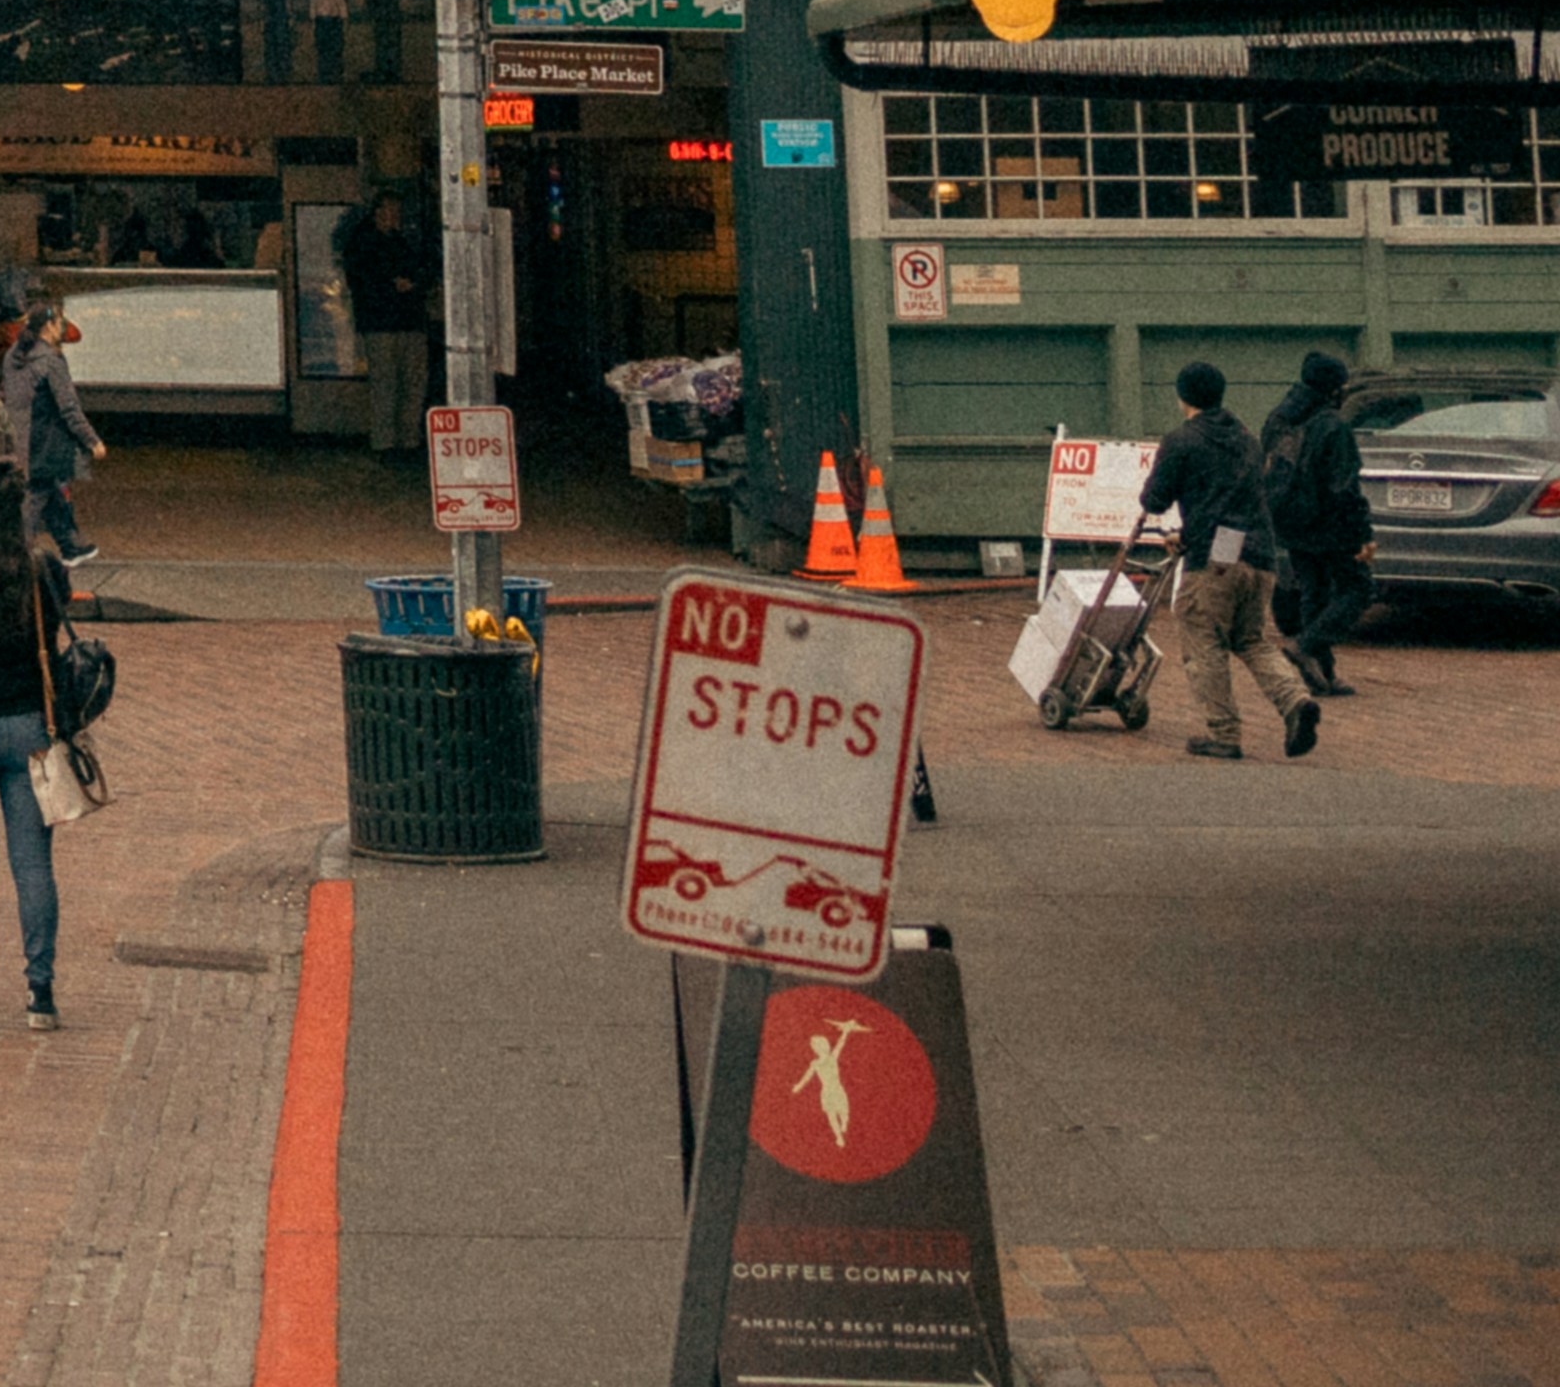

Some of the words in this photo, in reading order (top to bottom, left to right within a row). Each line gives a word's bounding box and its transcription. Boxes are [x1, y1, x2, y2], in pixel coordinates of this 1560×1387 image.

[498, 63, 538, 79] Pike
[539, 63, 588, 82] Place
[589, 65, 655, 84] Market
[1323, 131, 1452, 167] PRODUCE
[904, 301, 939, 312] SPACE
[908, 291, 934, 301] THIS
[434, 413, 456, 430] NO
[441, 437, 503, 458] STOPS
[1058, 447, 1091, 472] NO
[1056, 479, 1087, 489] FROM
[680, 596, 750, 651] NO
[687, 674, 882, 758] STOPS
[732, 1263, 835, 1282] COFFEE
[844, 1266, 972, 1285] COMPANY
[841, 1321, 885, 1334] BEST
